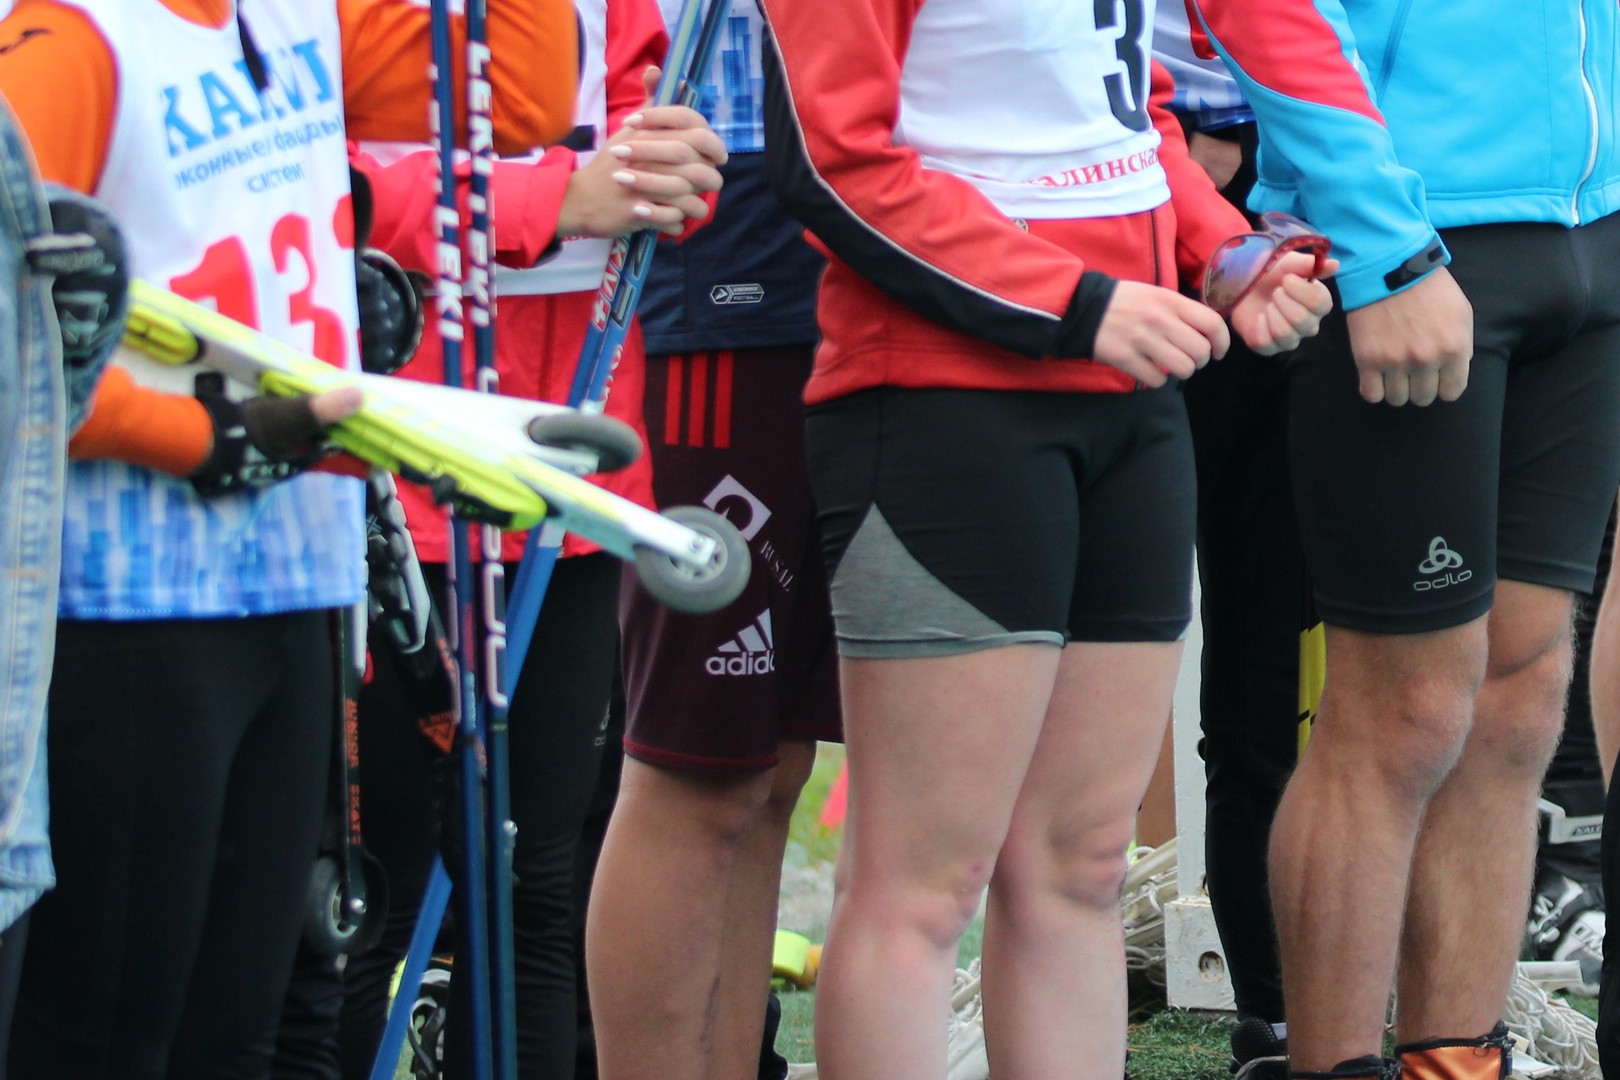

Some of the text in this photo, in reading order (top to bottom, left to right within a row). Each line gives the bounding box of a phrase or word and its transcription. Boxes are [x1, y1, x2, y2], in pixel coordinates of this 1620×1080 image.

[468, 40, 492, 174] LEKI
[434, 206, 464, 340] LEKI
[1413, 569, 1472, 591] odlo
